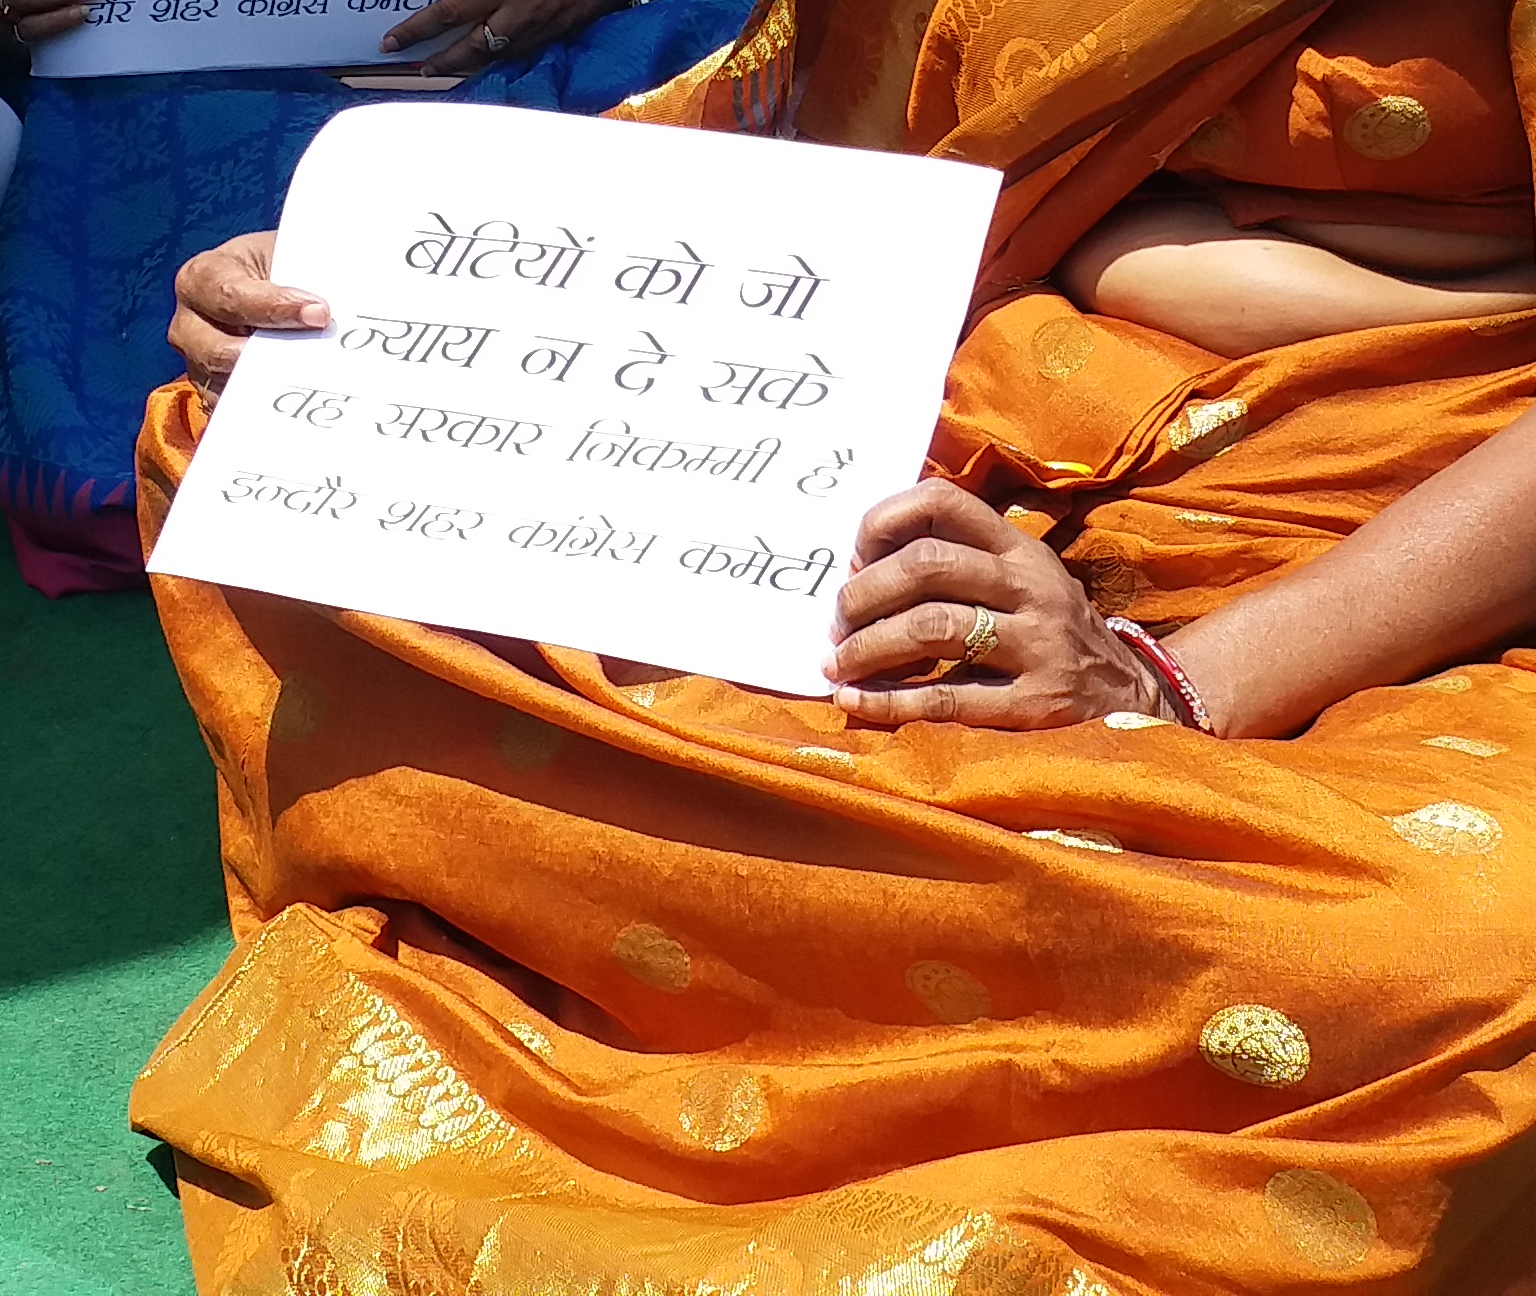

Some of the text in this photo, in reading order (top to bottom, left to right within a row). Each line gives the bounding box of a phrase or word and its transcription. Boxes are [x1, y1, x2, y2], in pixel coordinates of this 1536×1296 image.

[405, 212, 830, 320] बेटियों को जो
[340, 315, 844, 410] न्याय न दे सके
[273, 388, 854, 497] वह सरकार निकम्मी है
[220, 470, 838, 597] इन्दौर शहर कांग्रेस कमेटी
